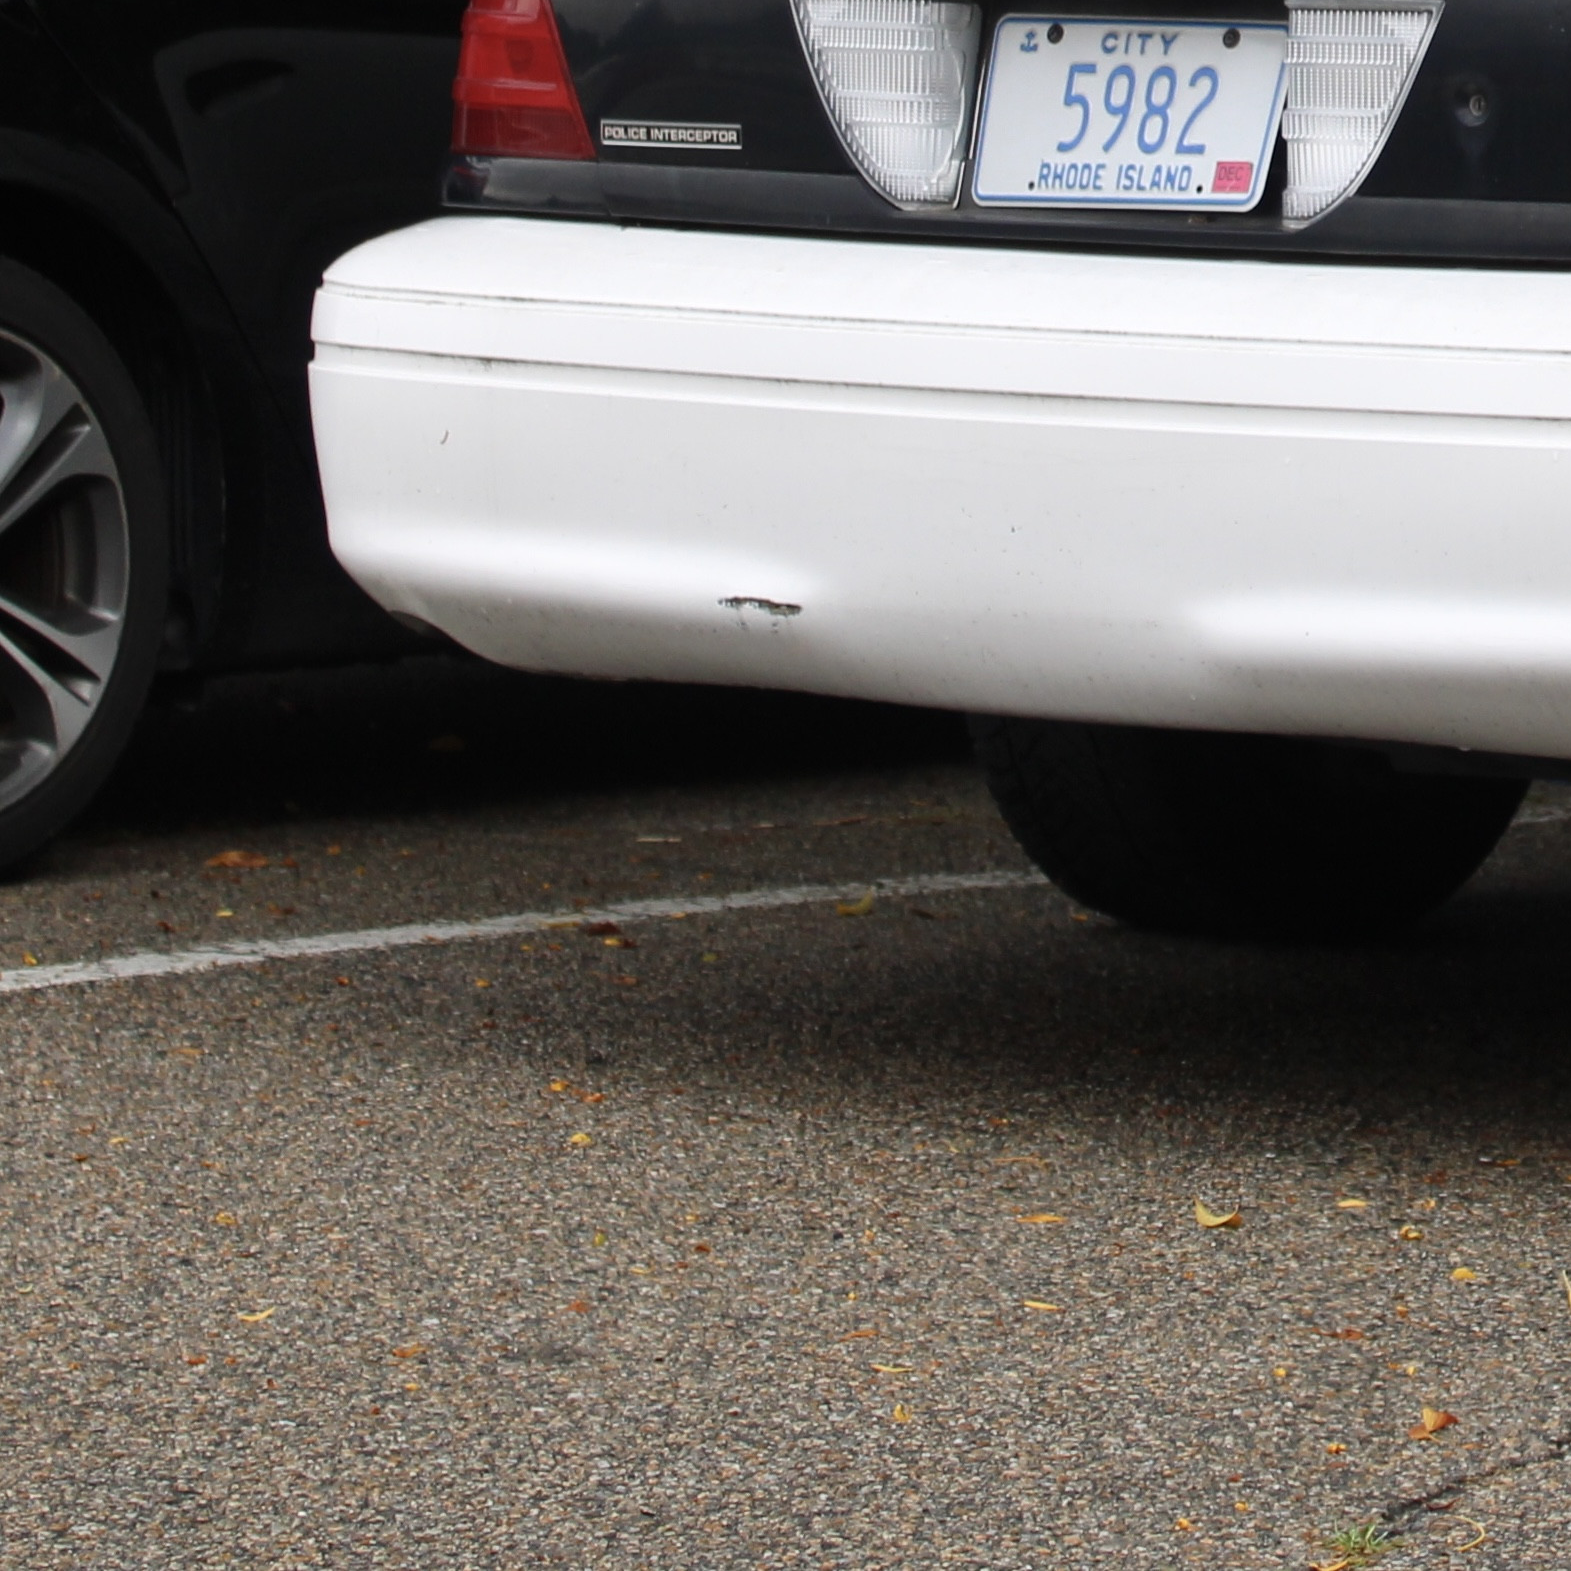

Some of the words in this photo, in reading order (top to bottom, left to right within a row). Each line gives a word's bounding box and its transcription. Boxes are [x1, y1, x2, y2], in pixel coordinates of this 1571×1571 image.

[1101, 31, 1180, 55] CITY
[1056, 63, 1220, 155] 5982
[604, 126, 647, 140] POLICE
[650, 128, 738, 143] INTERCEPTOR
[1037, 161, 1106, 190] RHODE
[1116, 163, 1193, 192] ISLAND
[1218, 166, 1245, 181] DEC
